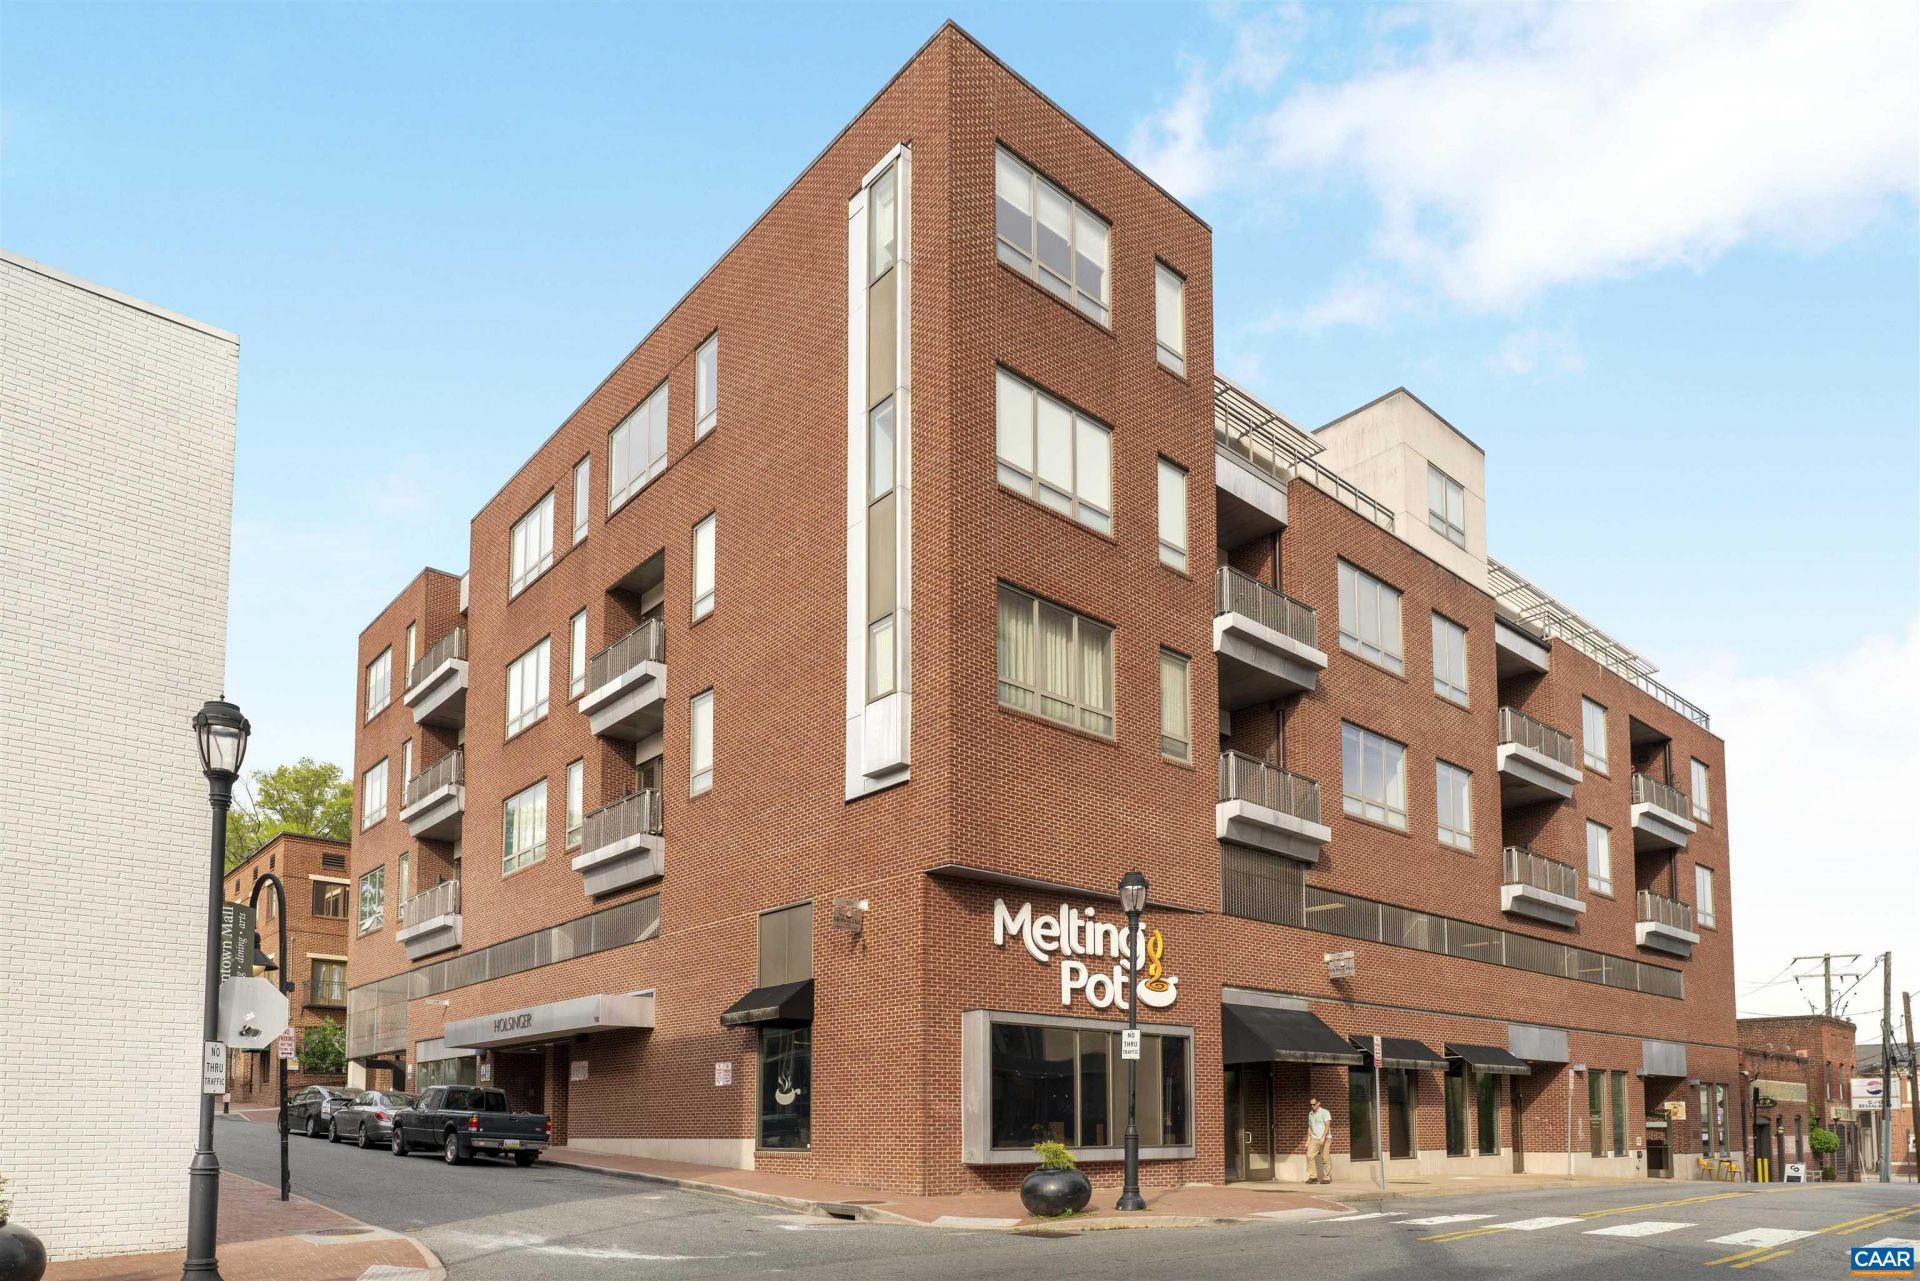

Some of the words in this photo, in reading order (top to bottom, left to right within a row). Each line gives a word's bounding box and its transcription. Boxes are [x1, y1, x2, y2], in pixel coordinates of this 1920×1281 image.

[221, 906, 234, 938] Mall
[239, 912, 247, 929] arts
[994, 898, 1146, 971] Melting
[220, 939, 233, 984] ntown
[234, 937, 248, 964] dining
[1061, 960, 1130, 1010] Pot
[494, 1013, 531, 1032] HOLSINGER
[211, 1046, 221, 1057] NO
[206, 1062, 224, 1073] THRU
[204, 1077, 225, 1086] TRAFFIC
